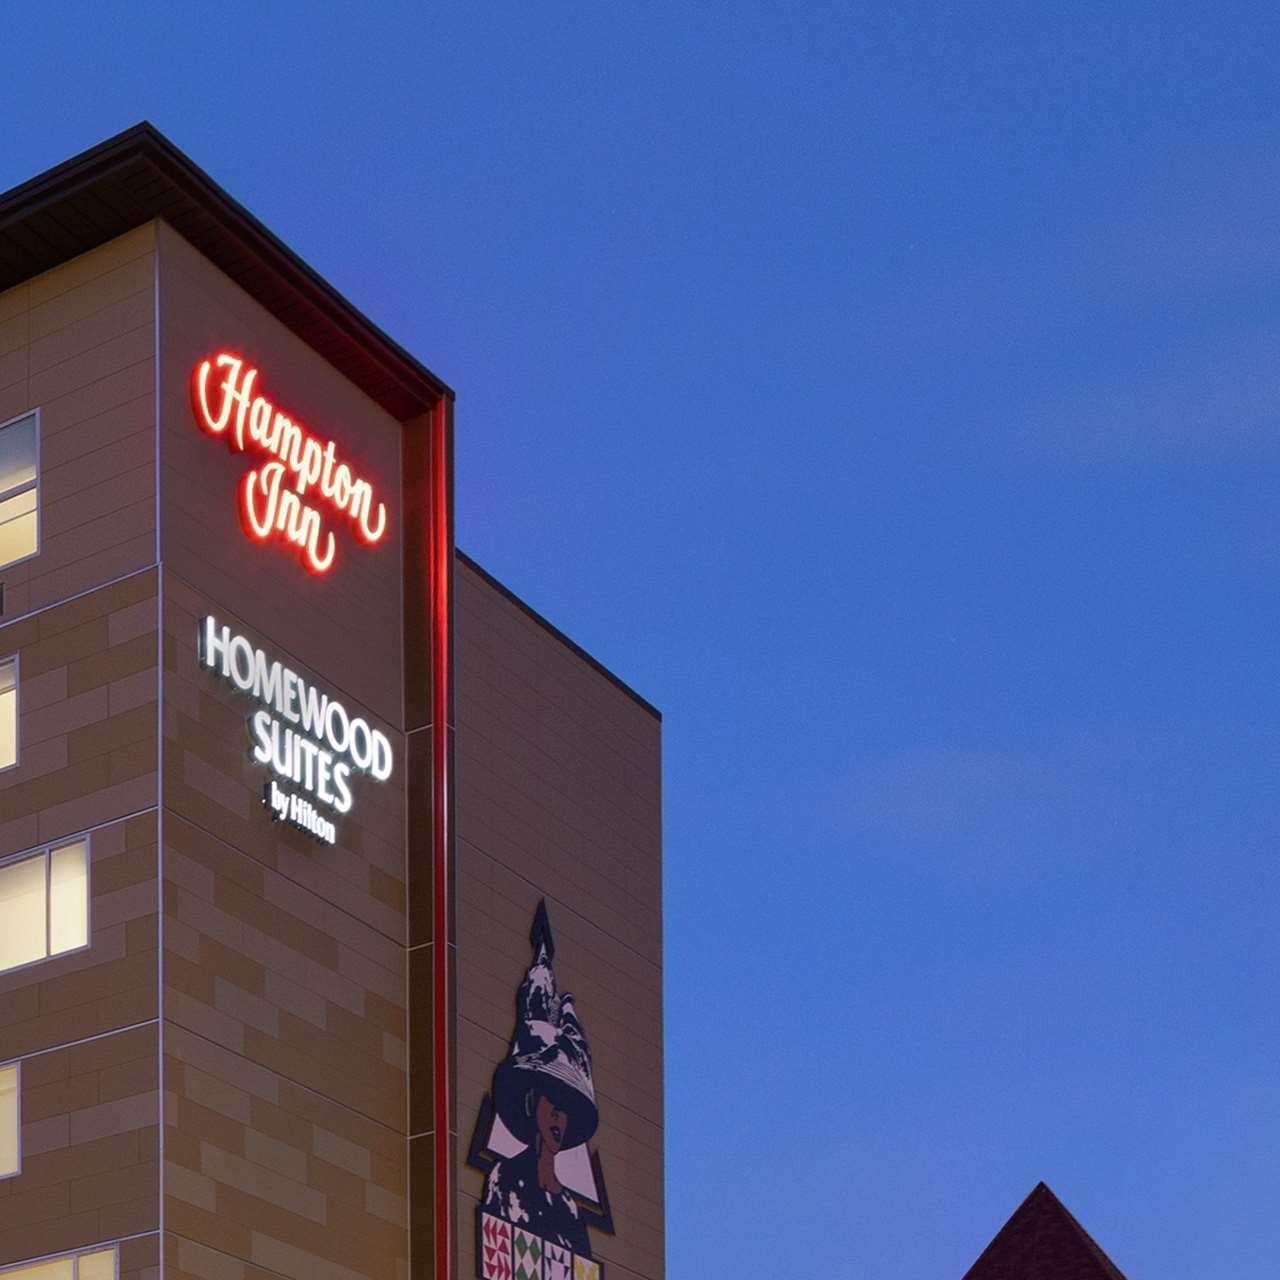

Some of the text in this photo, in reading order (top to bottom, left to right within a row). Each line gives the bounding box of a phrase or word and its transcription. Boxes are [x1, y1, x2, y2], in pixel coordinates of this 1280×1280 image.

[197, 353, 387, 543] Hampton
[245, 462, 336, 572] Inn
[204, 614, 393, 781] HOMEWOOD
[253, 710, 353, 814] SUITES
[271, 780, 336, 844] by Hilton
